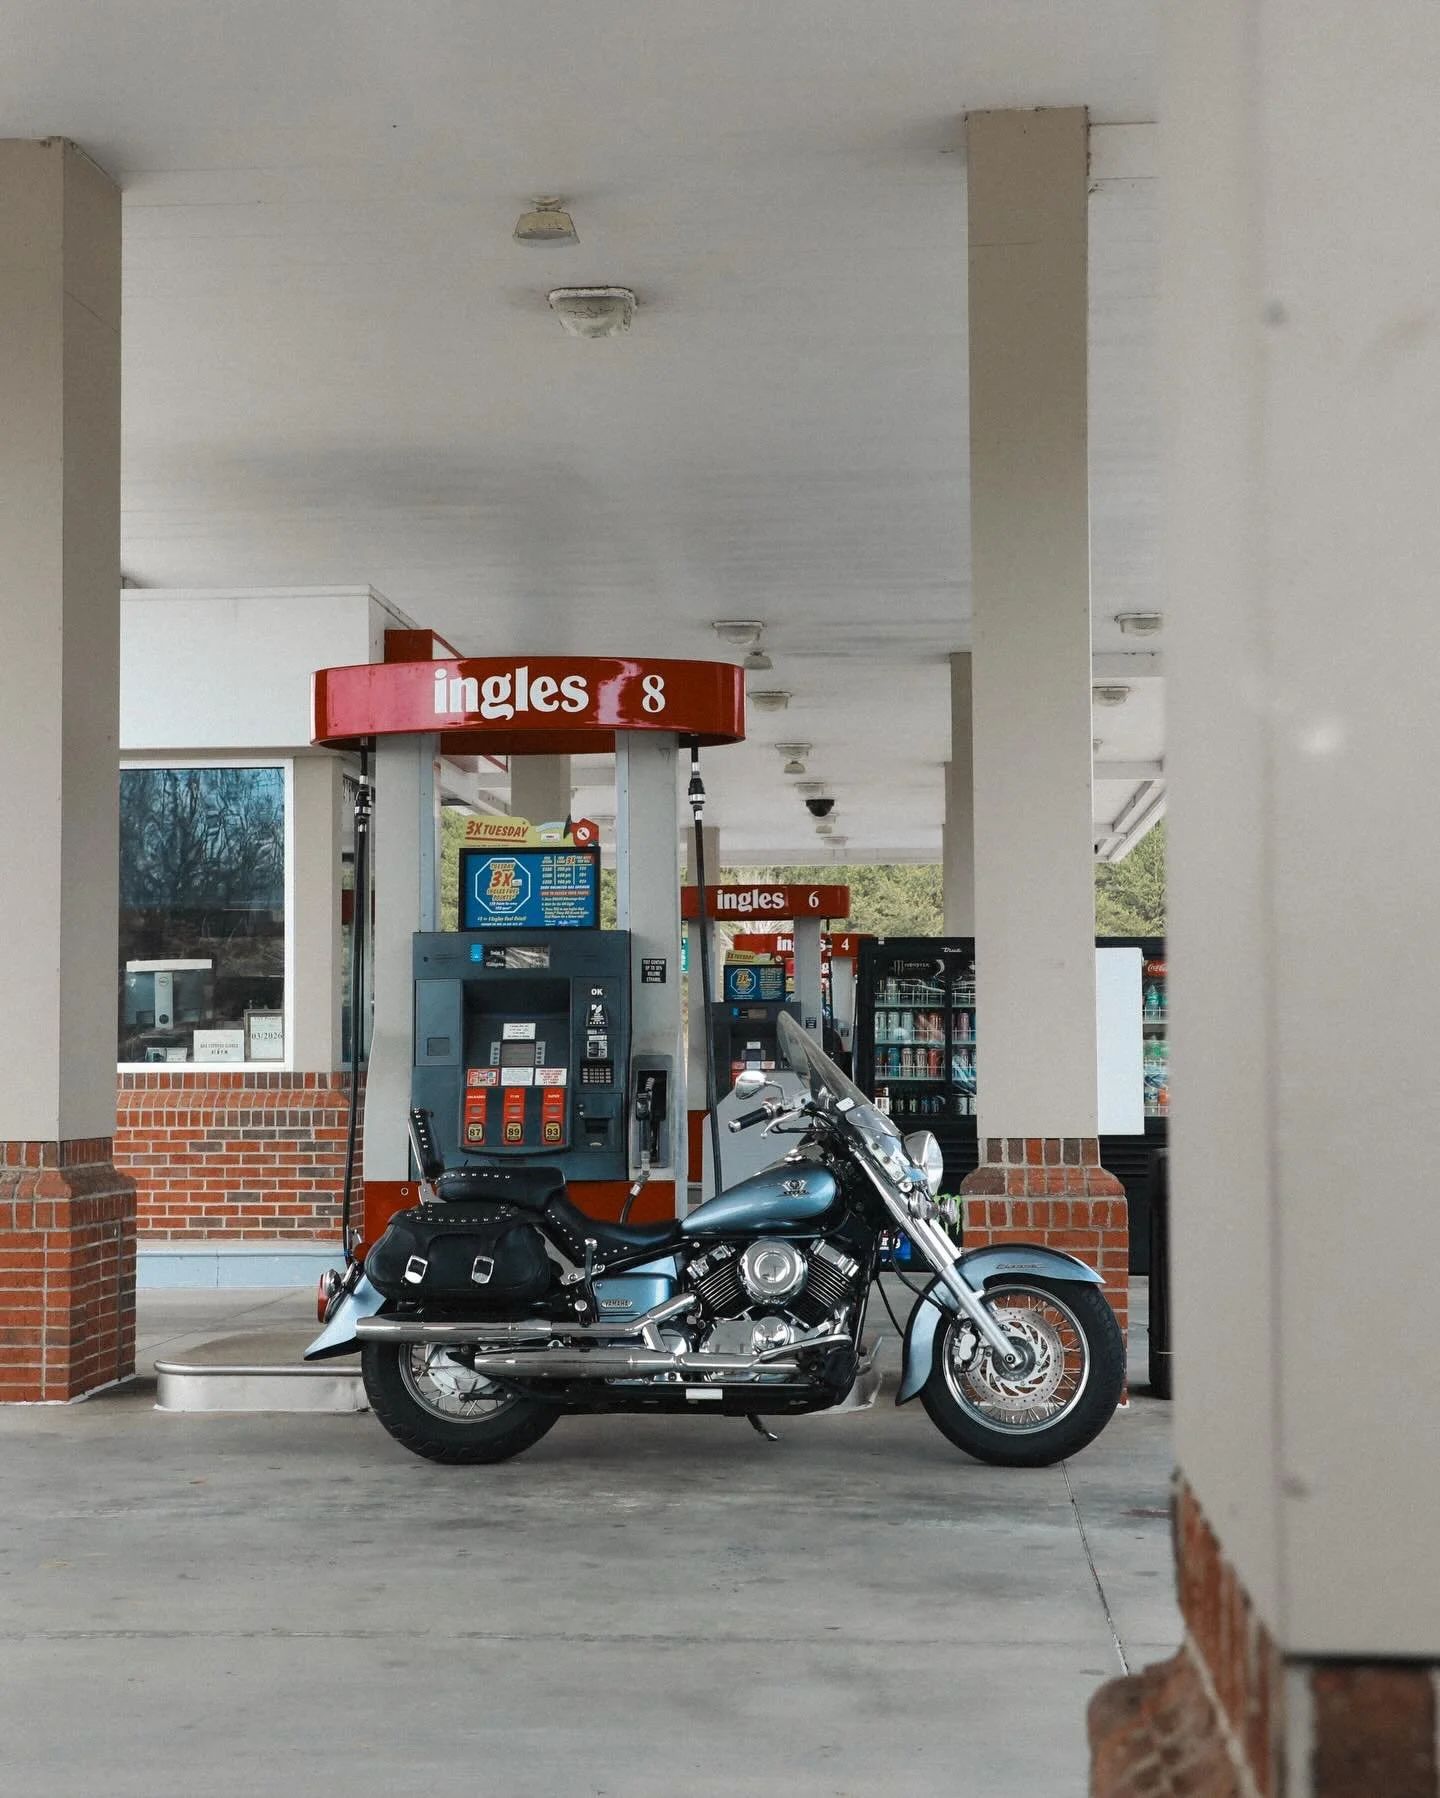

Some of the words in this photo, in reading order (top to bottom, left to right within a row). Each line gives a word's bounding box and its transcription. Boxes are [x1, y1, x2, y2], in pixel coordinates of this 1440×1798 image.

[434, 665, 589, 721] ingles
[641, 674, 666, 713] 8
[466, 820, 483, 836] 3X
[483, 823, 528, 838] TUESDAY
[491, 870, 513, 887] 3X
[717, 888, 785, 912] ingles
[808, 890, 820, 908] 6
[841, 937, 850, 951] 4
[591, 988, 603, 996] OK
[251, 1031, 283, 1040] 03/2026
[508, 1128, 520, 1136] 89
[547, 1128, 558, 1136] 93
